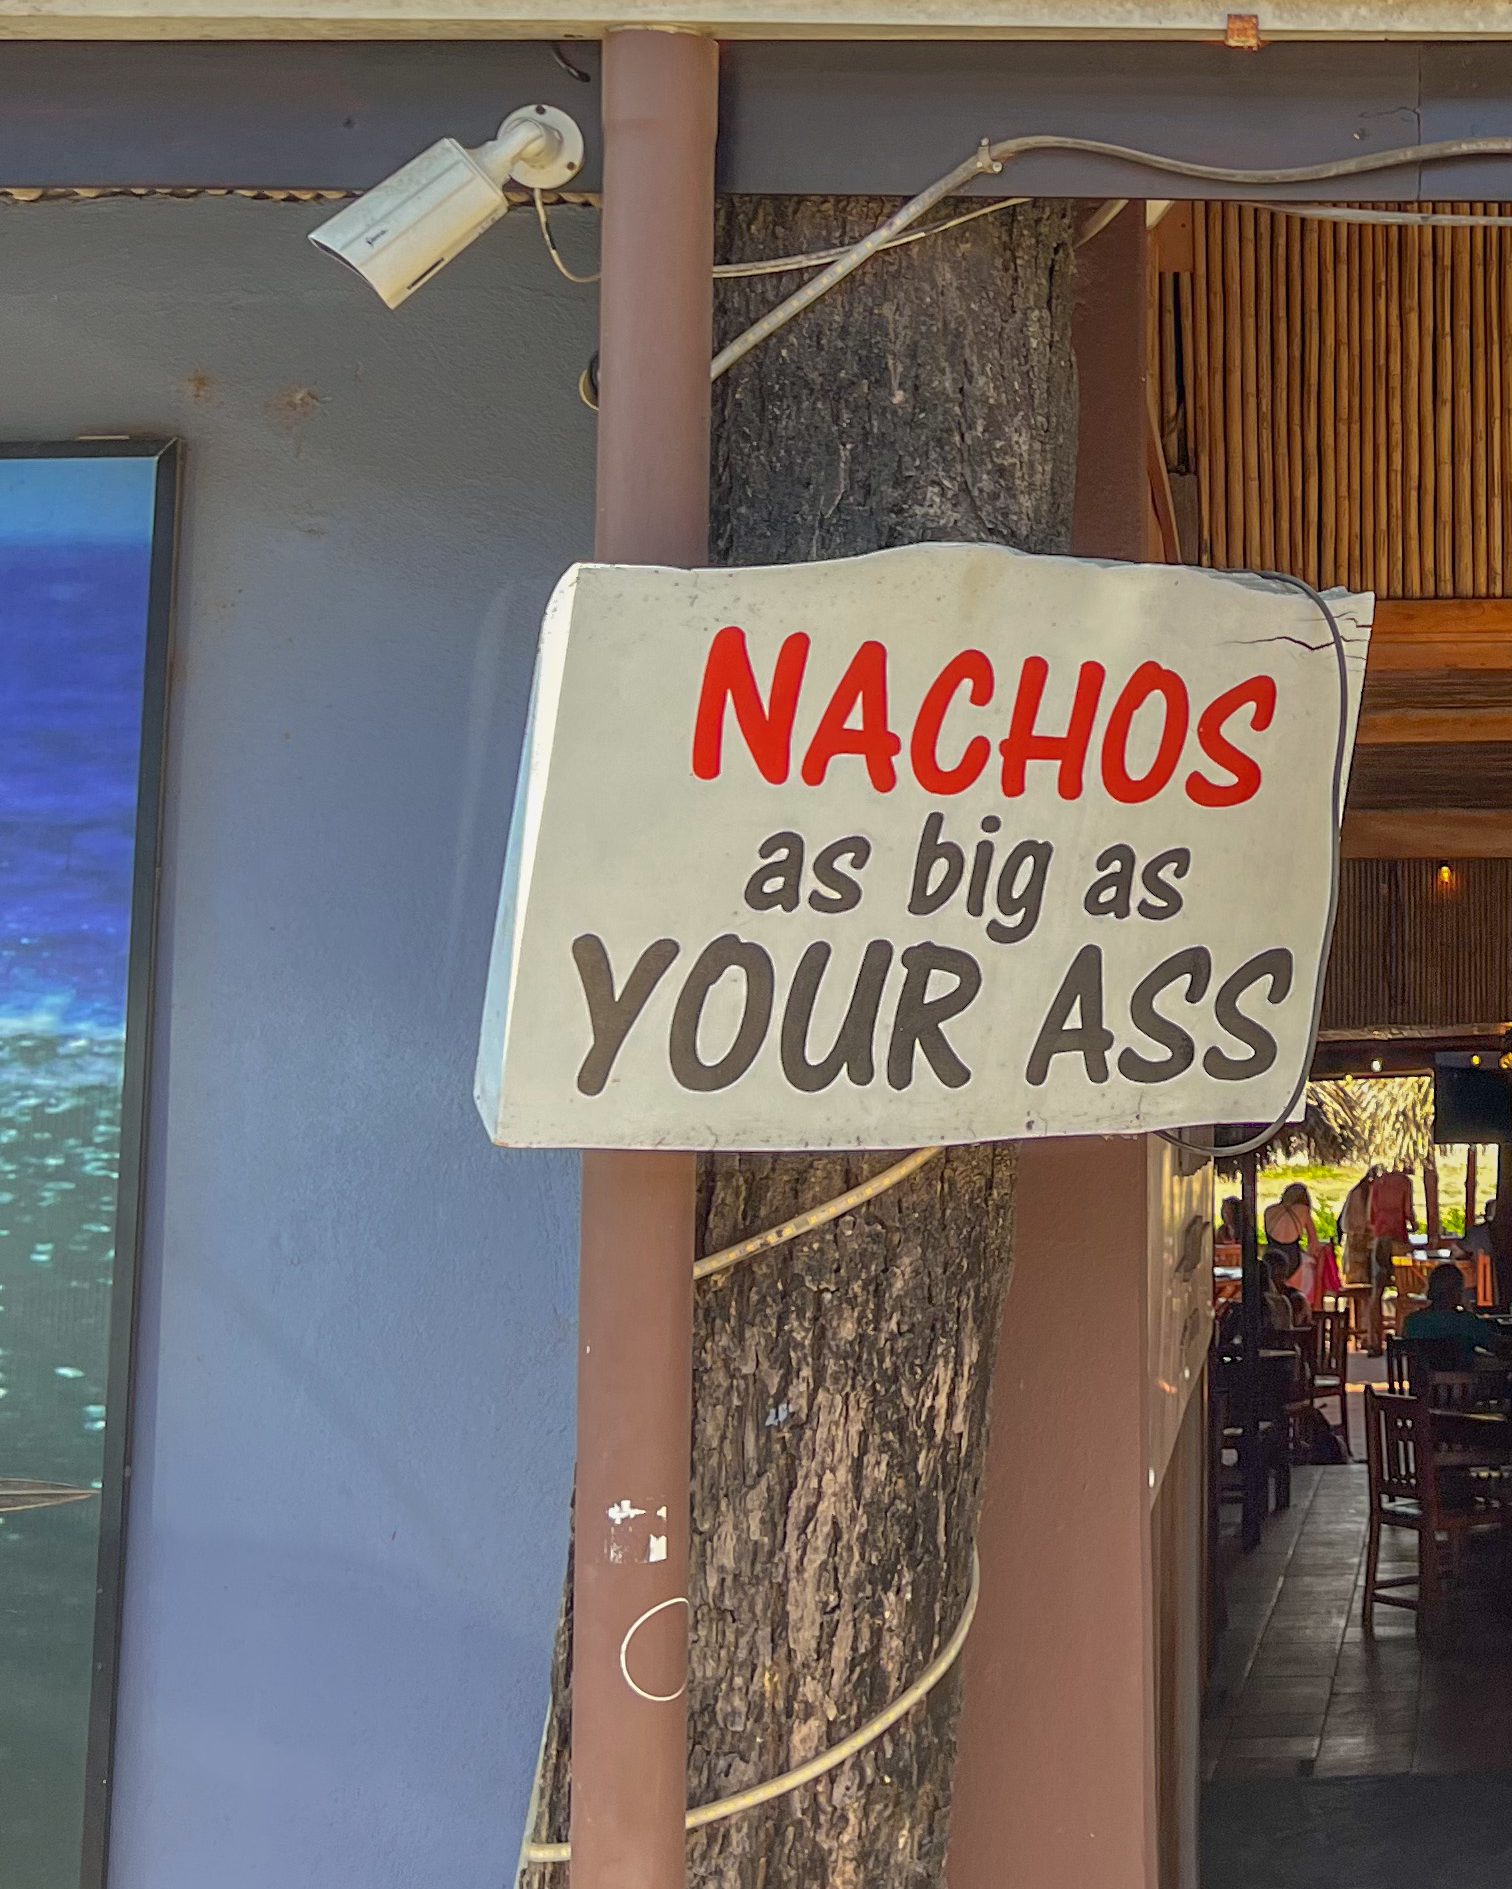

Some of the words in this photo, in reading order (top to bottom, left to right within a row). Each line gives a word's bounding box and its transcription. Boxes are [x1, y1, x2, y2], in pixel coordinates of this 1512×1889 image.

[691, 625, 1276, 808] NACHOS
[743, 830, 871, 914] as
[907, 811, 1054, 944] big
[1083, 843, 1192, 921] as
[571, 932, 984, 1097] YOUR
[1025, 943, 1293, 1086] ASS
